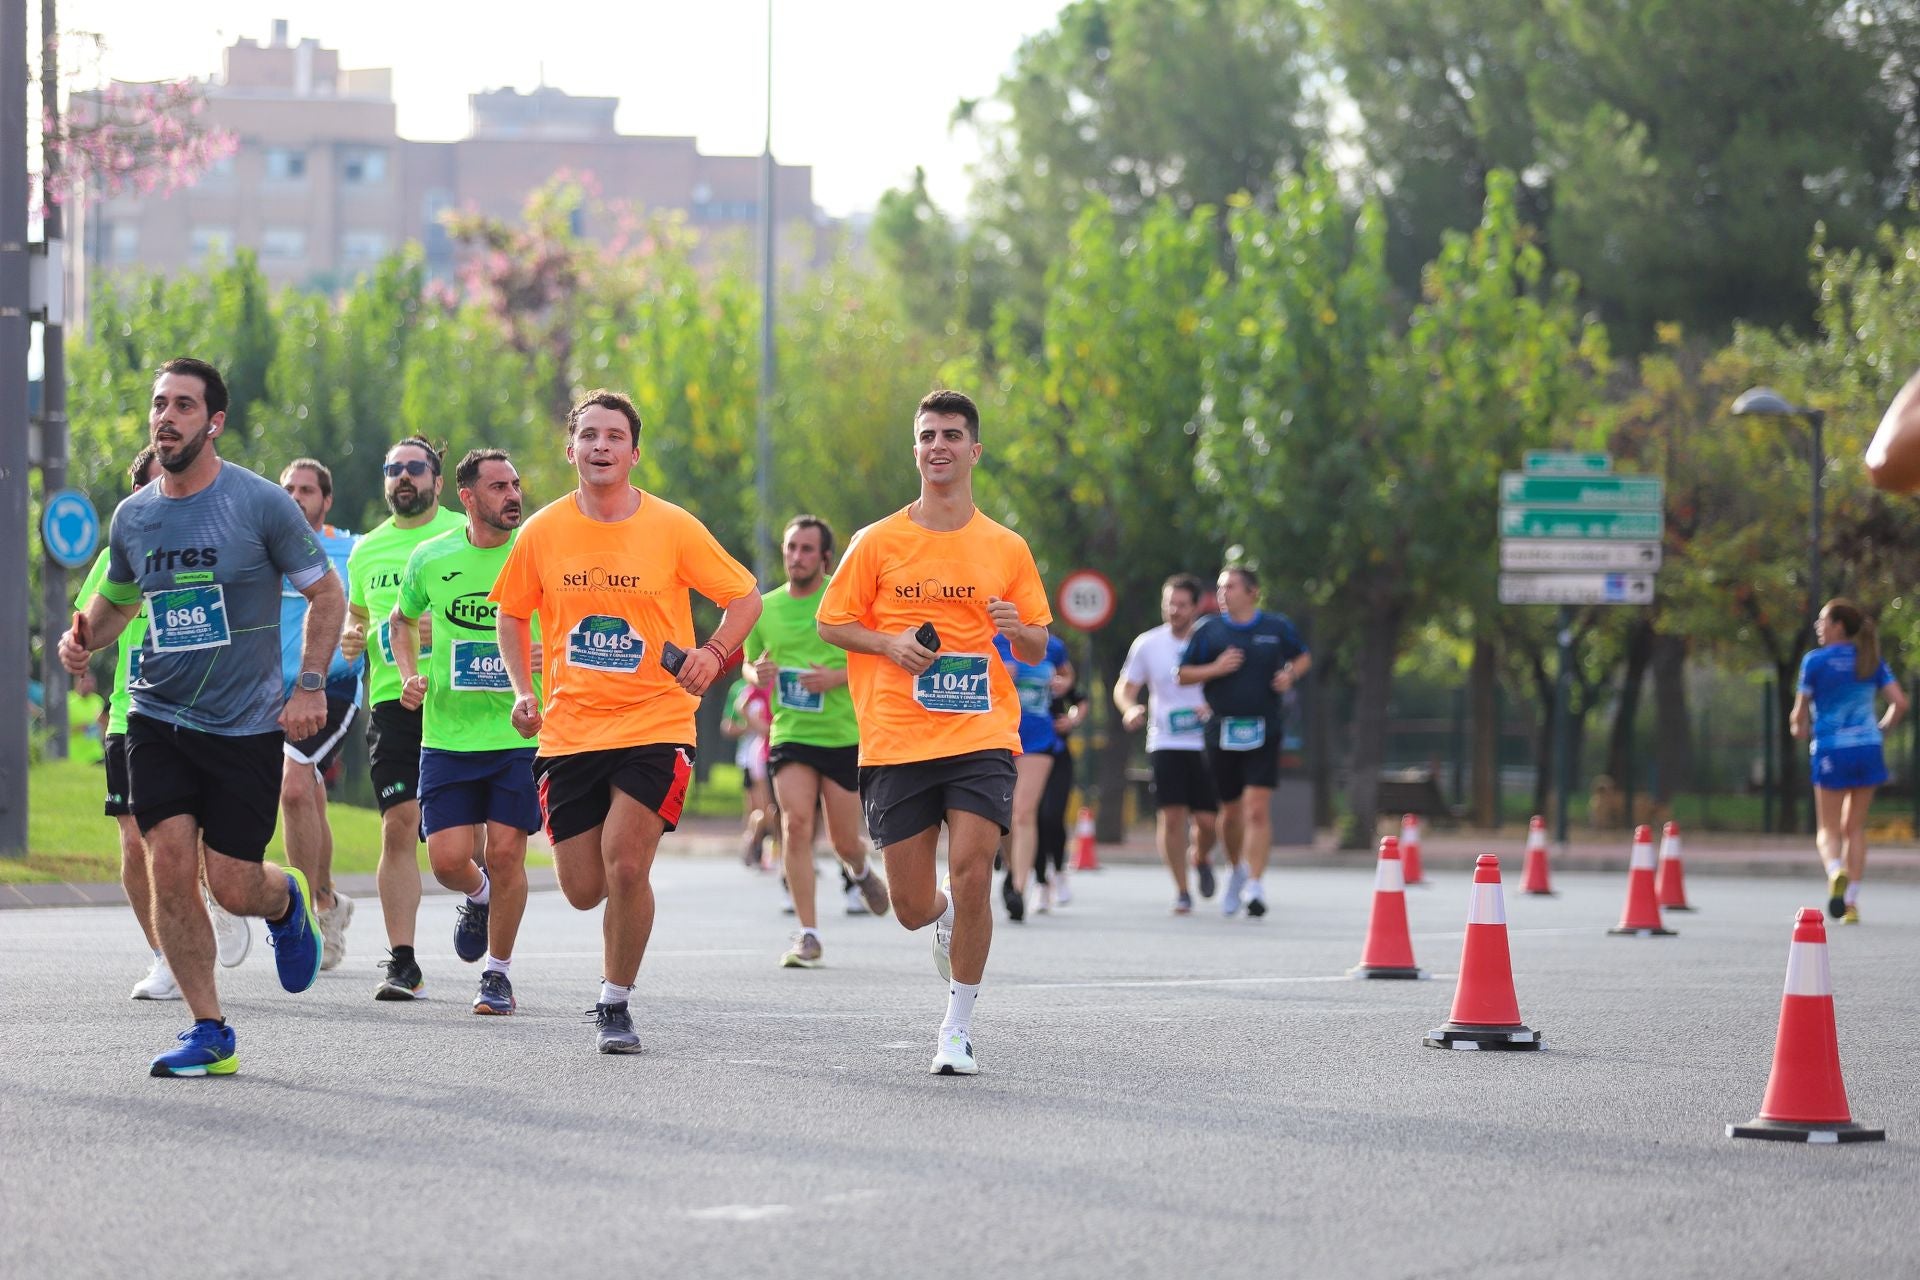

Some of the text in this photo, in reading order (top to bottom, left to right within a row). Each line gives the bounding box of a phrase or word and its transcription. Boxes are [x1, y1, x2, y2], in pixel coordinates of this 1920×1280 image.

[145, 546, 218, 574] itres
[563, 567, 640, 591] seiQuer
[895, 578, 976, 602] seiQuer
[166, 606, 207, 627] 686
[583, 631, 633, 650] 1048
[469, 656, 505, 672] 460
[931, 673, 979, 691] 1047
